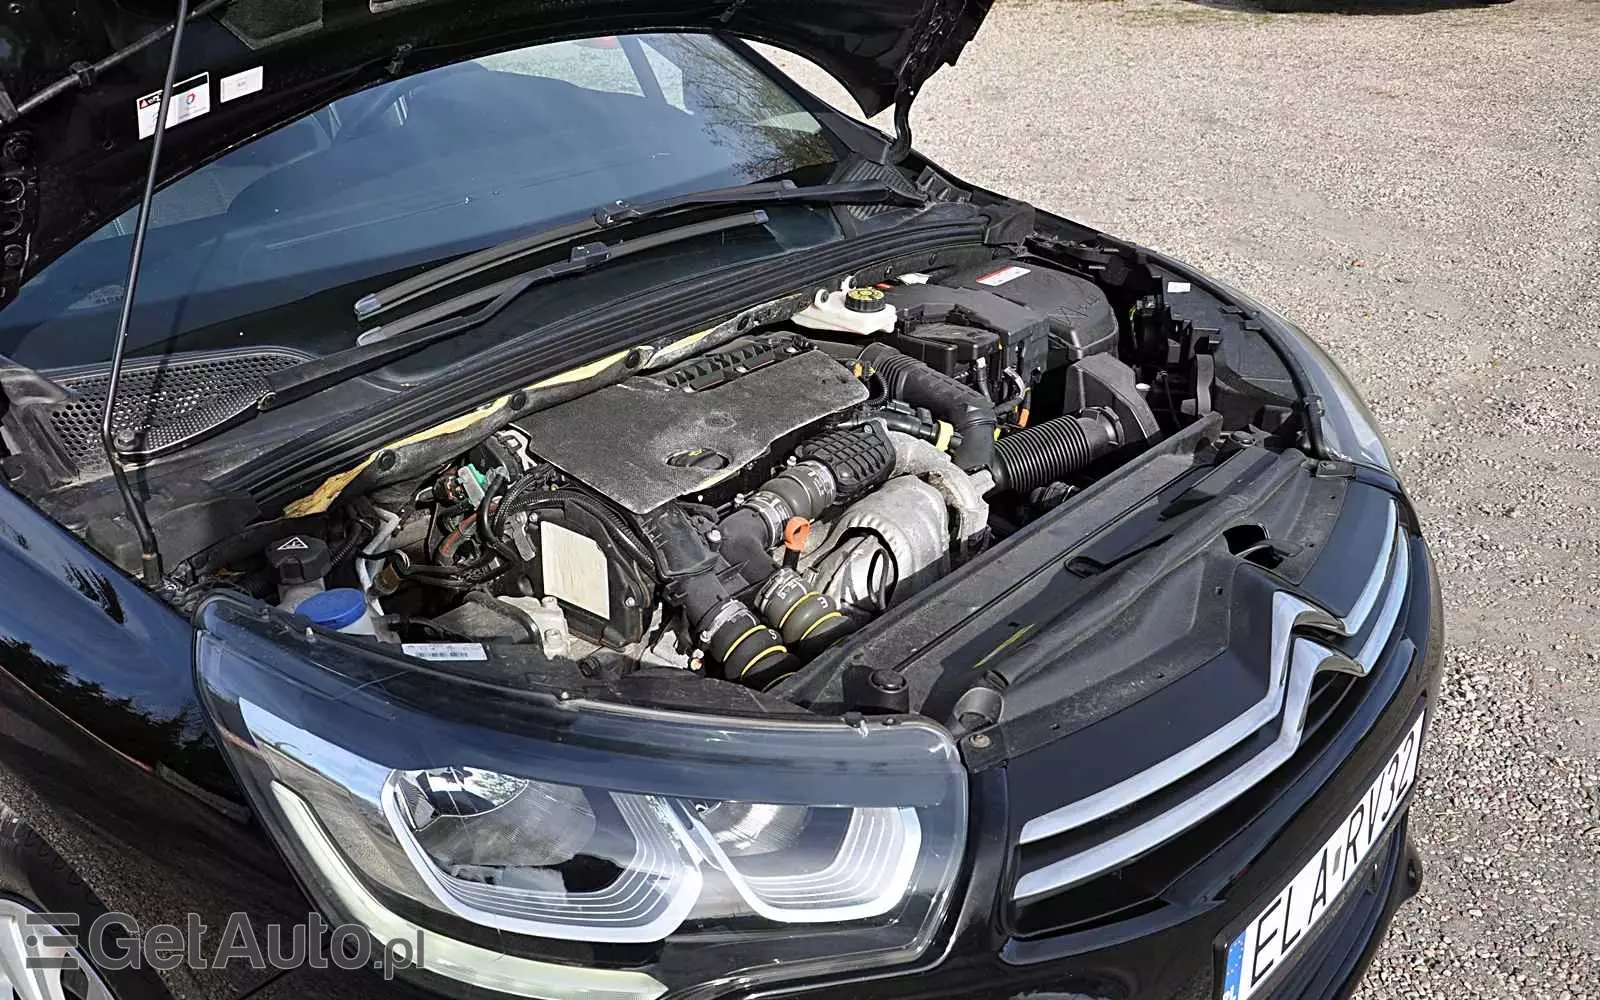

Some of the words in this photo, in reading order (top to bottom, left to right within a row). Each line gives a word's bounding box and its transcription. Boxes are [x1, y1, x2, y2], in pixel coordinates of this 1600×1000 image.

[768, 628, 777, 640] S
[1250, 848, 1328, 988] ELA
[1342, 731, 1415, 882] RV32
